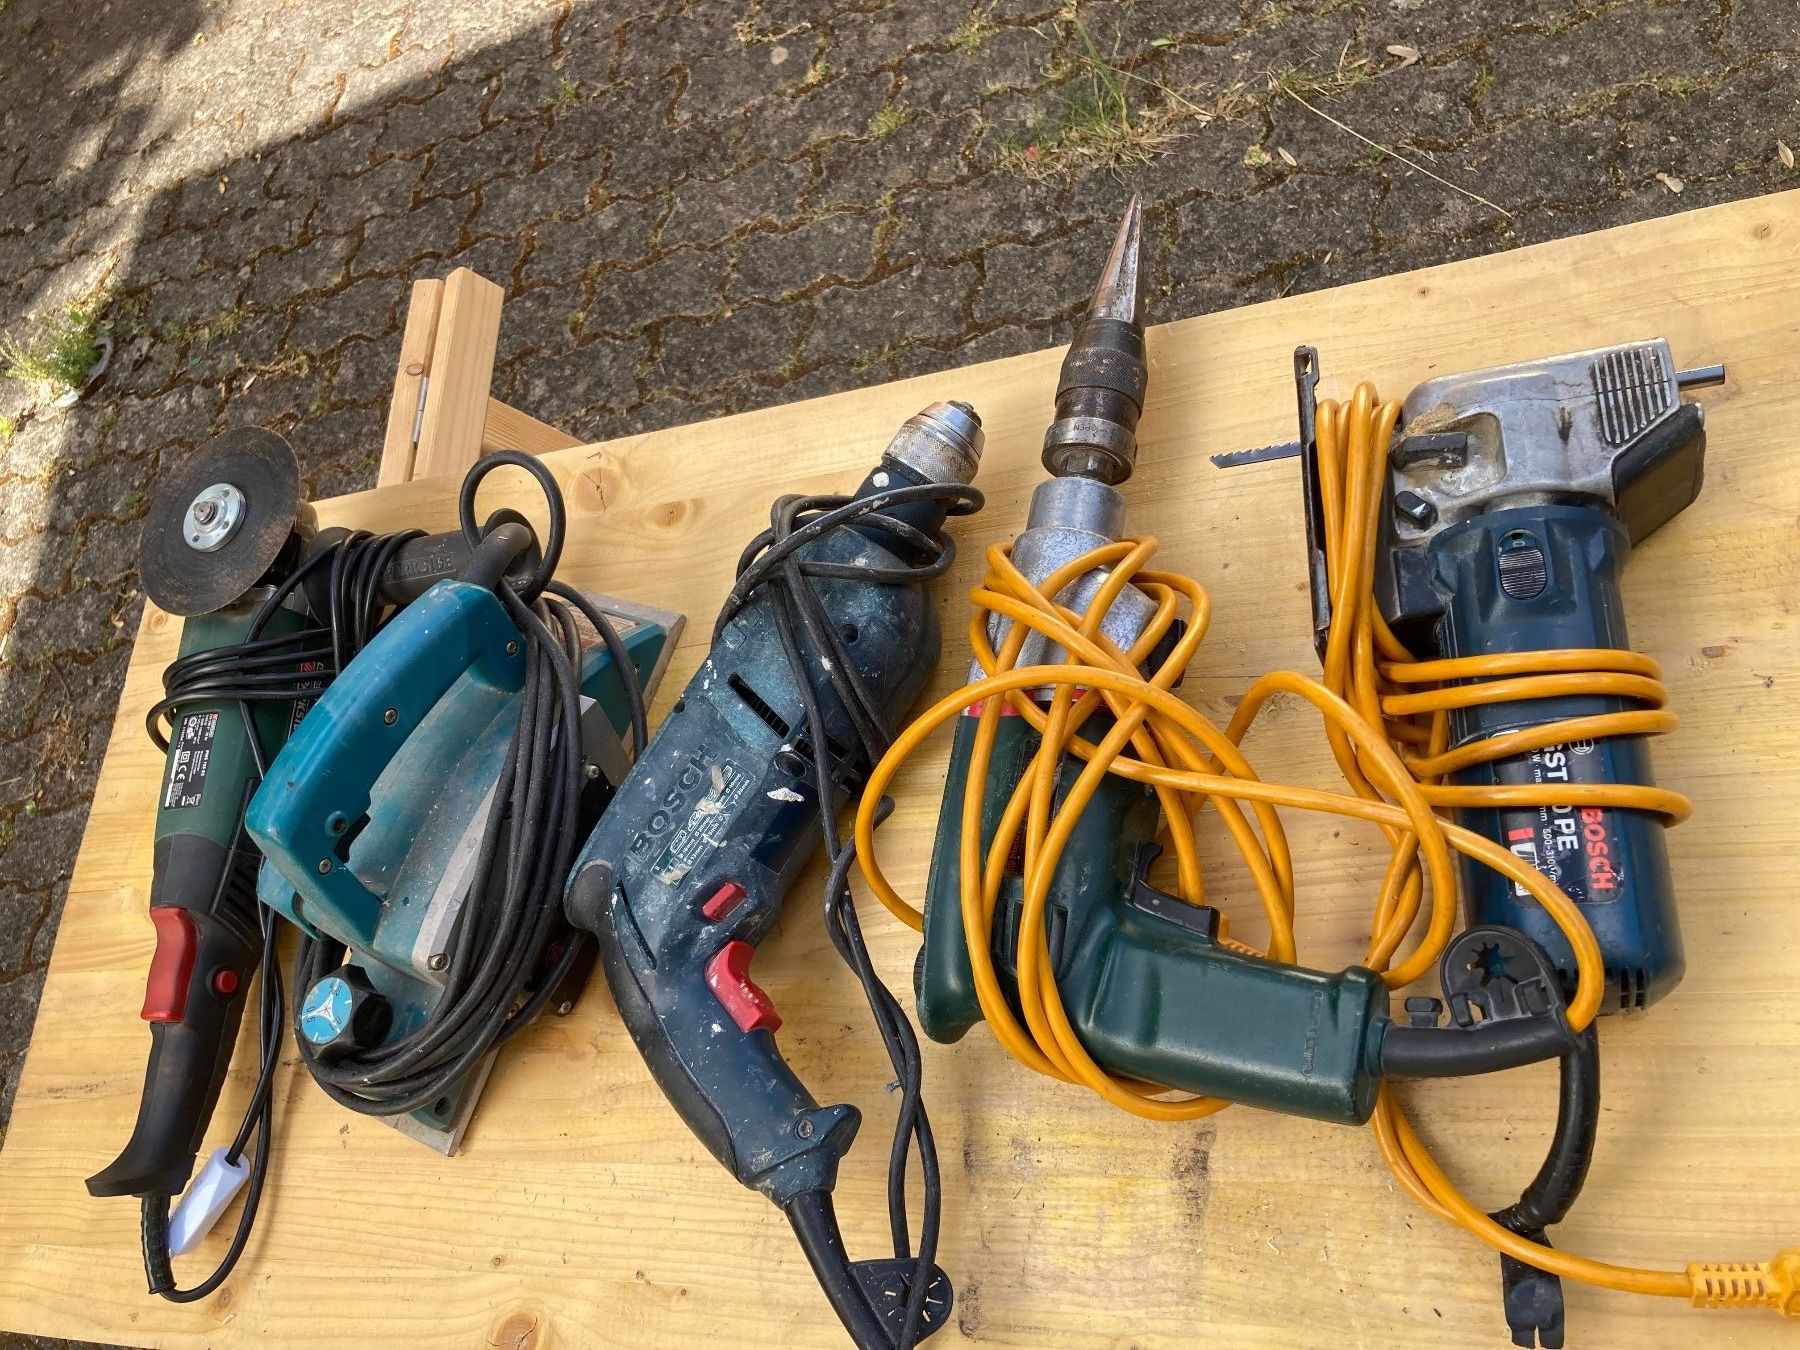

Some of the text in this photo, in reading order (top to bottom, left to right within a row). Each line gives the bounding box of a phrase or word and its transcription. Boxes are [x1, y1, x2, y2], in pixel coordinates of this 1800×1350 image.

[630, 744, 718, 860] BOSCH
[1552, 816, 1579, 852] PE
[1581, 807, 1617, 890] BOSCH
